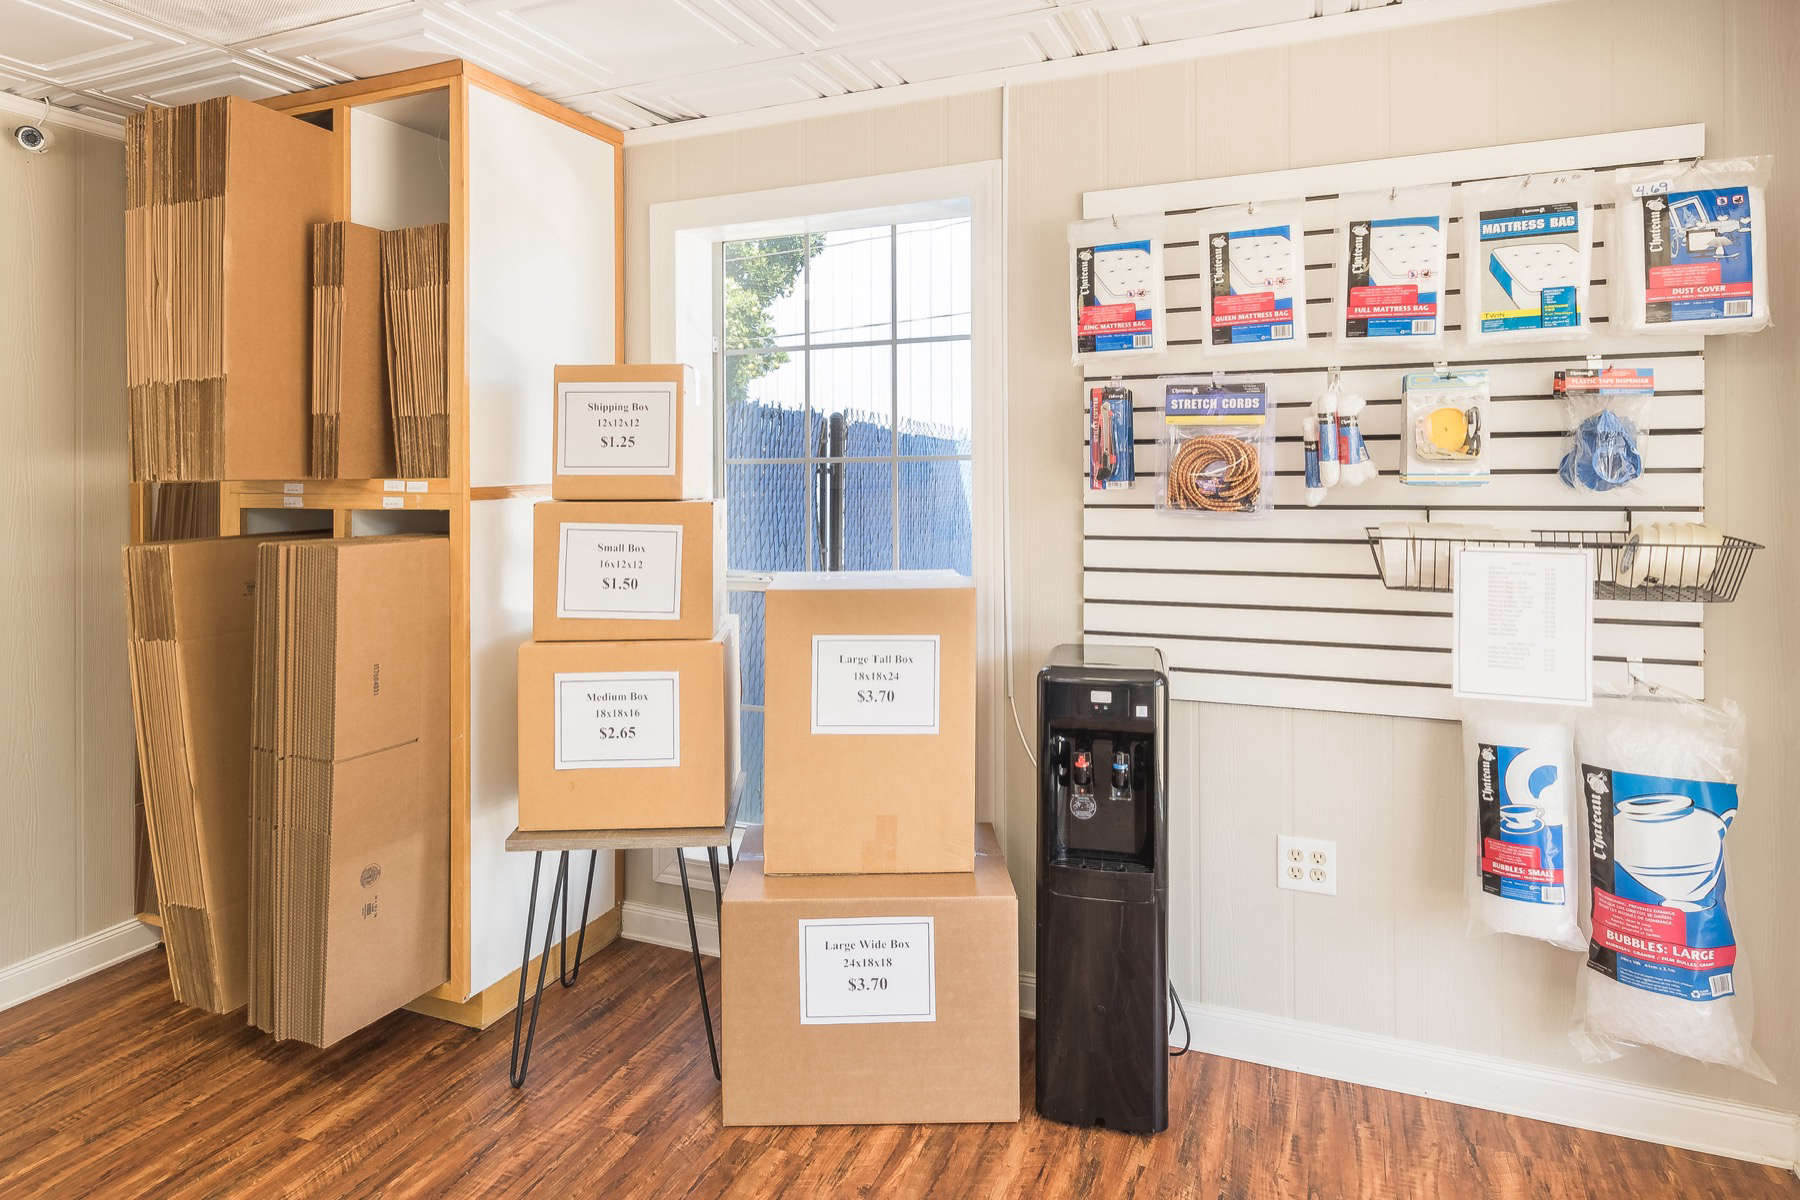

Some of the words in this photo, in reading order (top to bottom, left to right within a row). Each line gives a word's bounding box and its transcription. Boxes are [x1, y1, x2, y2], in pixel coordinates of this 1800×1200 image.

[1635, 182, 1669, 196] 4.69
[1482, 218, 1545, 235] MATTRESS
[1549, 215, 1575, 228] BAG
[1672, 287, 1695, 295] DUST
[1697, 284, 1726, 293] COVER
[1372, 304, 1411, 313] MATTRESS
[1215, 314, 1237, 322] QUEEN
[1238, 311, 1273, 320] MATTRESS
[1274, 309, 1289, 317] BAG
[1100, 321, 1132, 330] MATTRESS
[587, 402, 629, 413] Shipping
[632, 402, 649, 412] Box
[1170, 398, 1218, 410] STRETCH
[1221, 397, 1260, 409] CORDS
[597, 418, 640, 428] 12x12x12
[600, 435, 636, 448] $1.25
[597, 543, 625, 553] Small
[628, 544, 646, 553] Box
[600, 559, 643, 569] 16x12x12
[602, 577, 639, 590] $1.50
[839, 654, 869, 665] Large
[872, 654, 892, 664] Tall
[895, 654, 914, 664] Box
[853, 671, 900, 681] 18x18x24
[586, 692, 627, 702] Medium
[630, 691, 649, 701] Box
[857, 689, 895, 703] $3.70
[596, 708, 641, 718] 18x18x16
[600, 726, 637, 740] $2.65
[1481, 761, 1494, 802] Chateau
[1592, 793, 1607, 861] Chateau
[1491, 861, 1527, 875] BUBBLES:
[825, 940, 856, 951] Large
[859, 939, 887, 949] Wide
[890, 939, 910, 949] Box
[1606, 929, 1669, 954] BUBBLES:
[1672, 946, 1715, 960] LARGE
[843, 958, 893, 968] 24x18x18
[848, 977, 888, 991] $3.70
